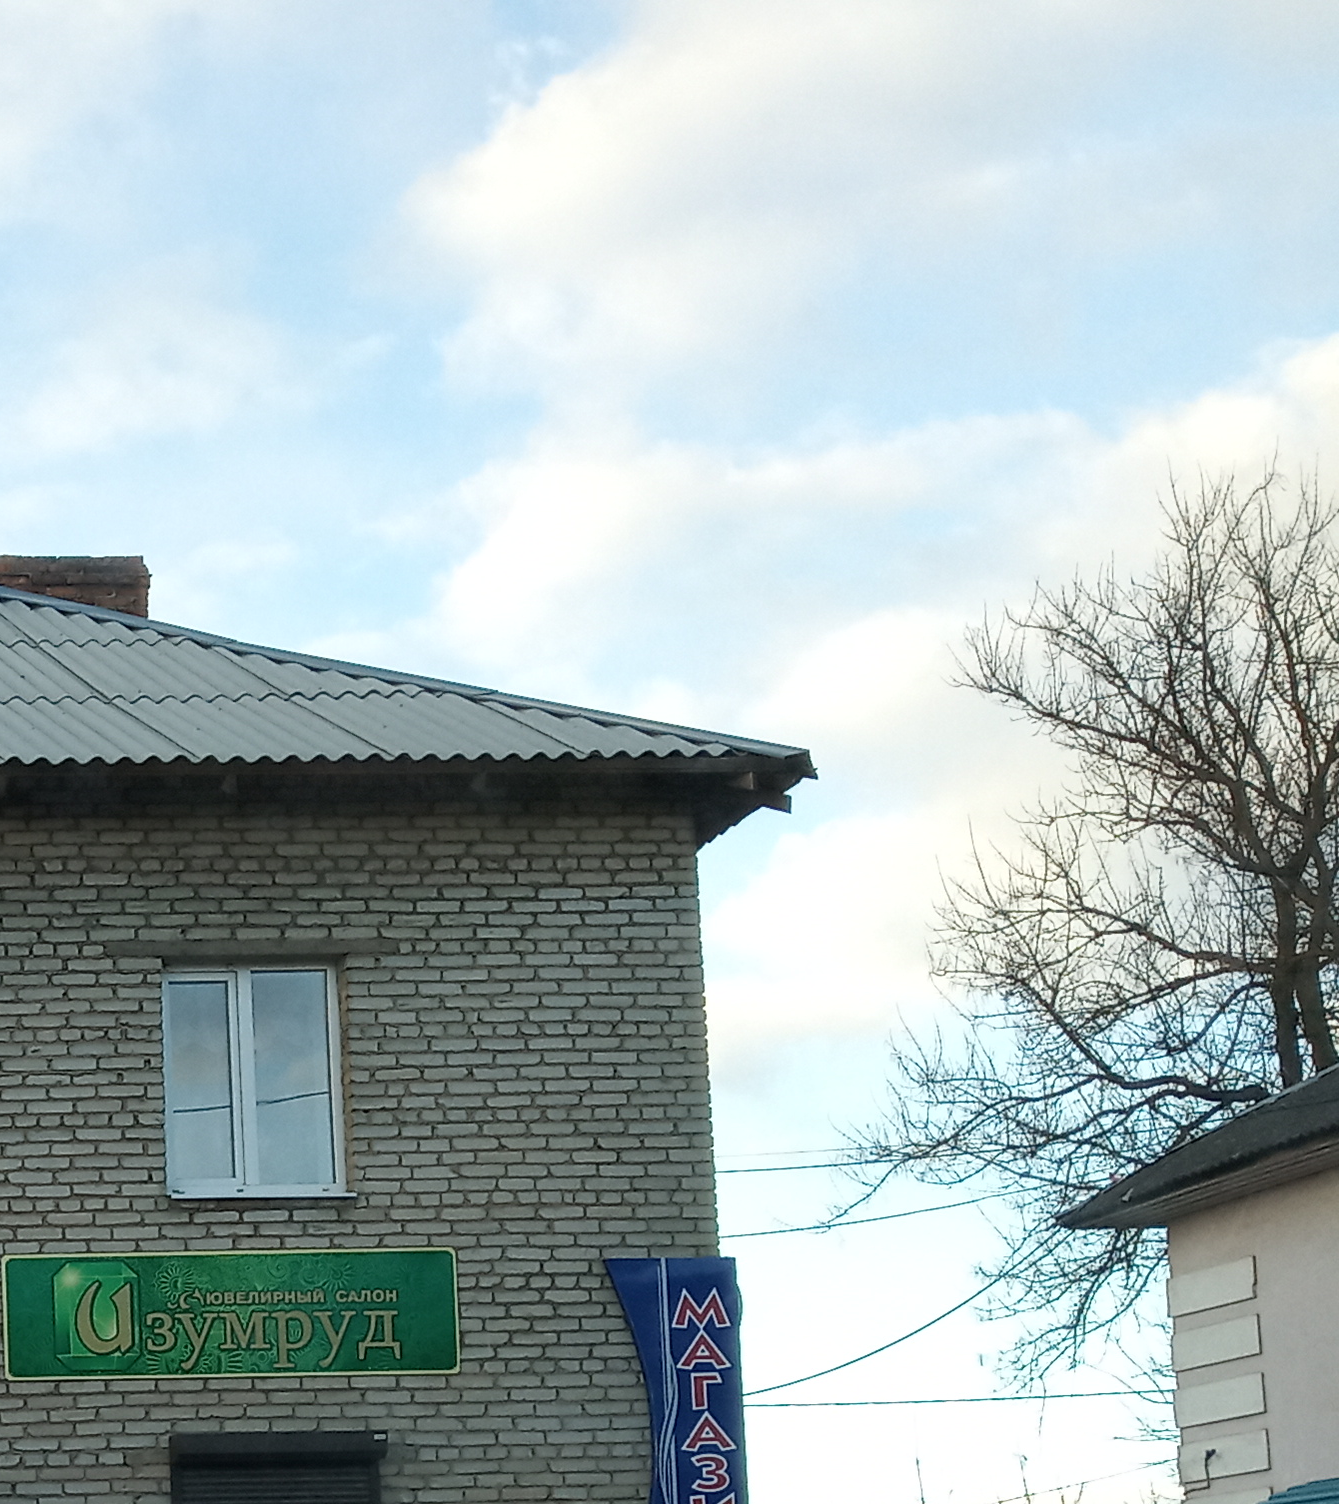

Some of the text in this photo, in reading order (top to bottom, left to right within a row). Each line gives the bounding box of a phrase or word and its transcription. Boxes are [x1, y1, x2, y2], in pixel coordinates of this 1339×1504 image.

[205, 1289, 397, 1304] ЮВЕЛИРНЫЙ САЛОН
[75, 1280, 402, 1371] Изумруд
